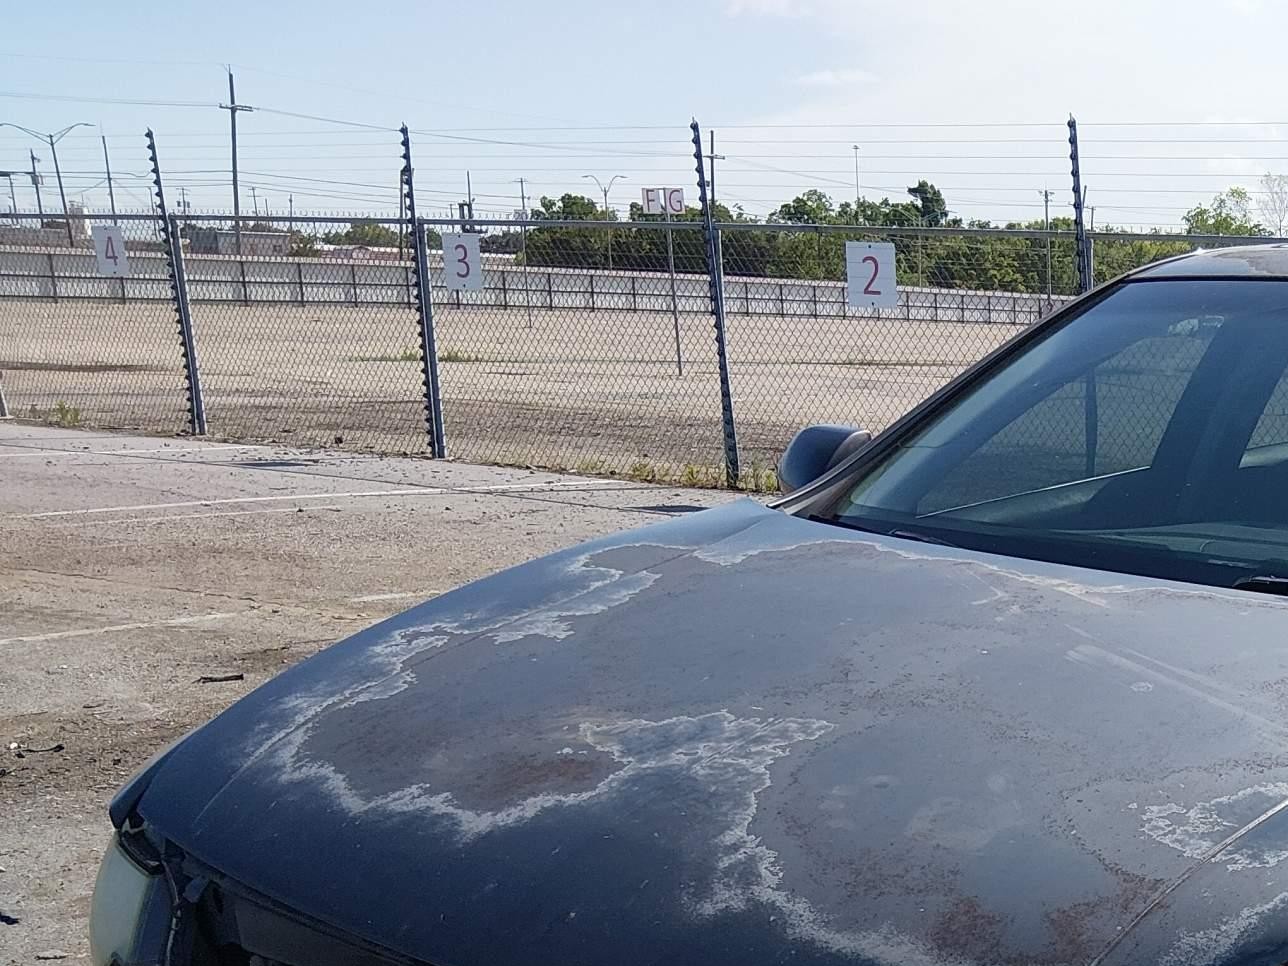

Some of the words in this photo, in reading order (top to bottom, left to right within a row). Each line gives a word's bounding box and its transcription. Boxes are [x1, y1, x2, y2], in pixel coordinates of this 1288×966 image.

[645, 188, 655, 212] F
[669, 189, 683, 212] G
[105, 236, 118, 266] 4
[455, 243, 470, 278] 3
[862, 255, 881, 295] 2
